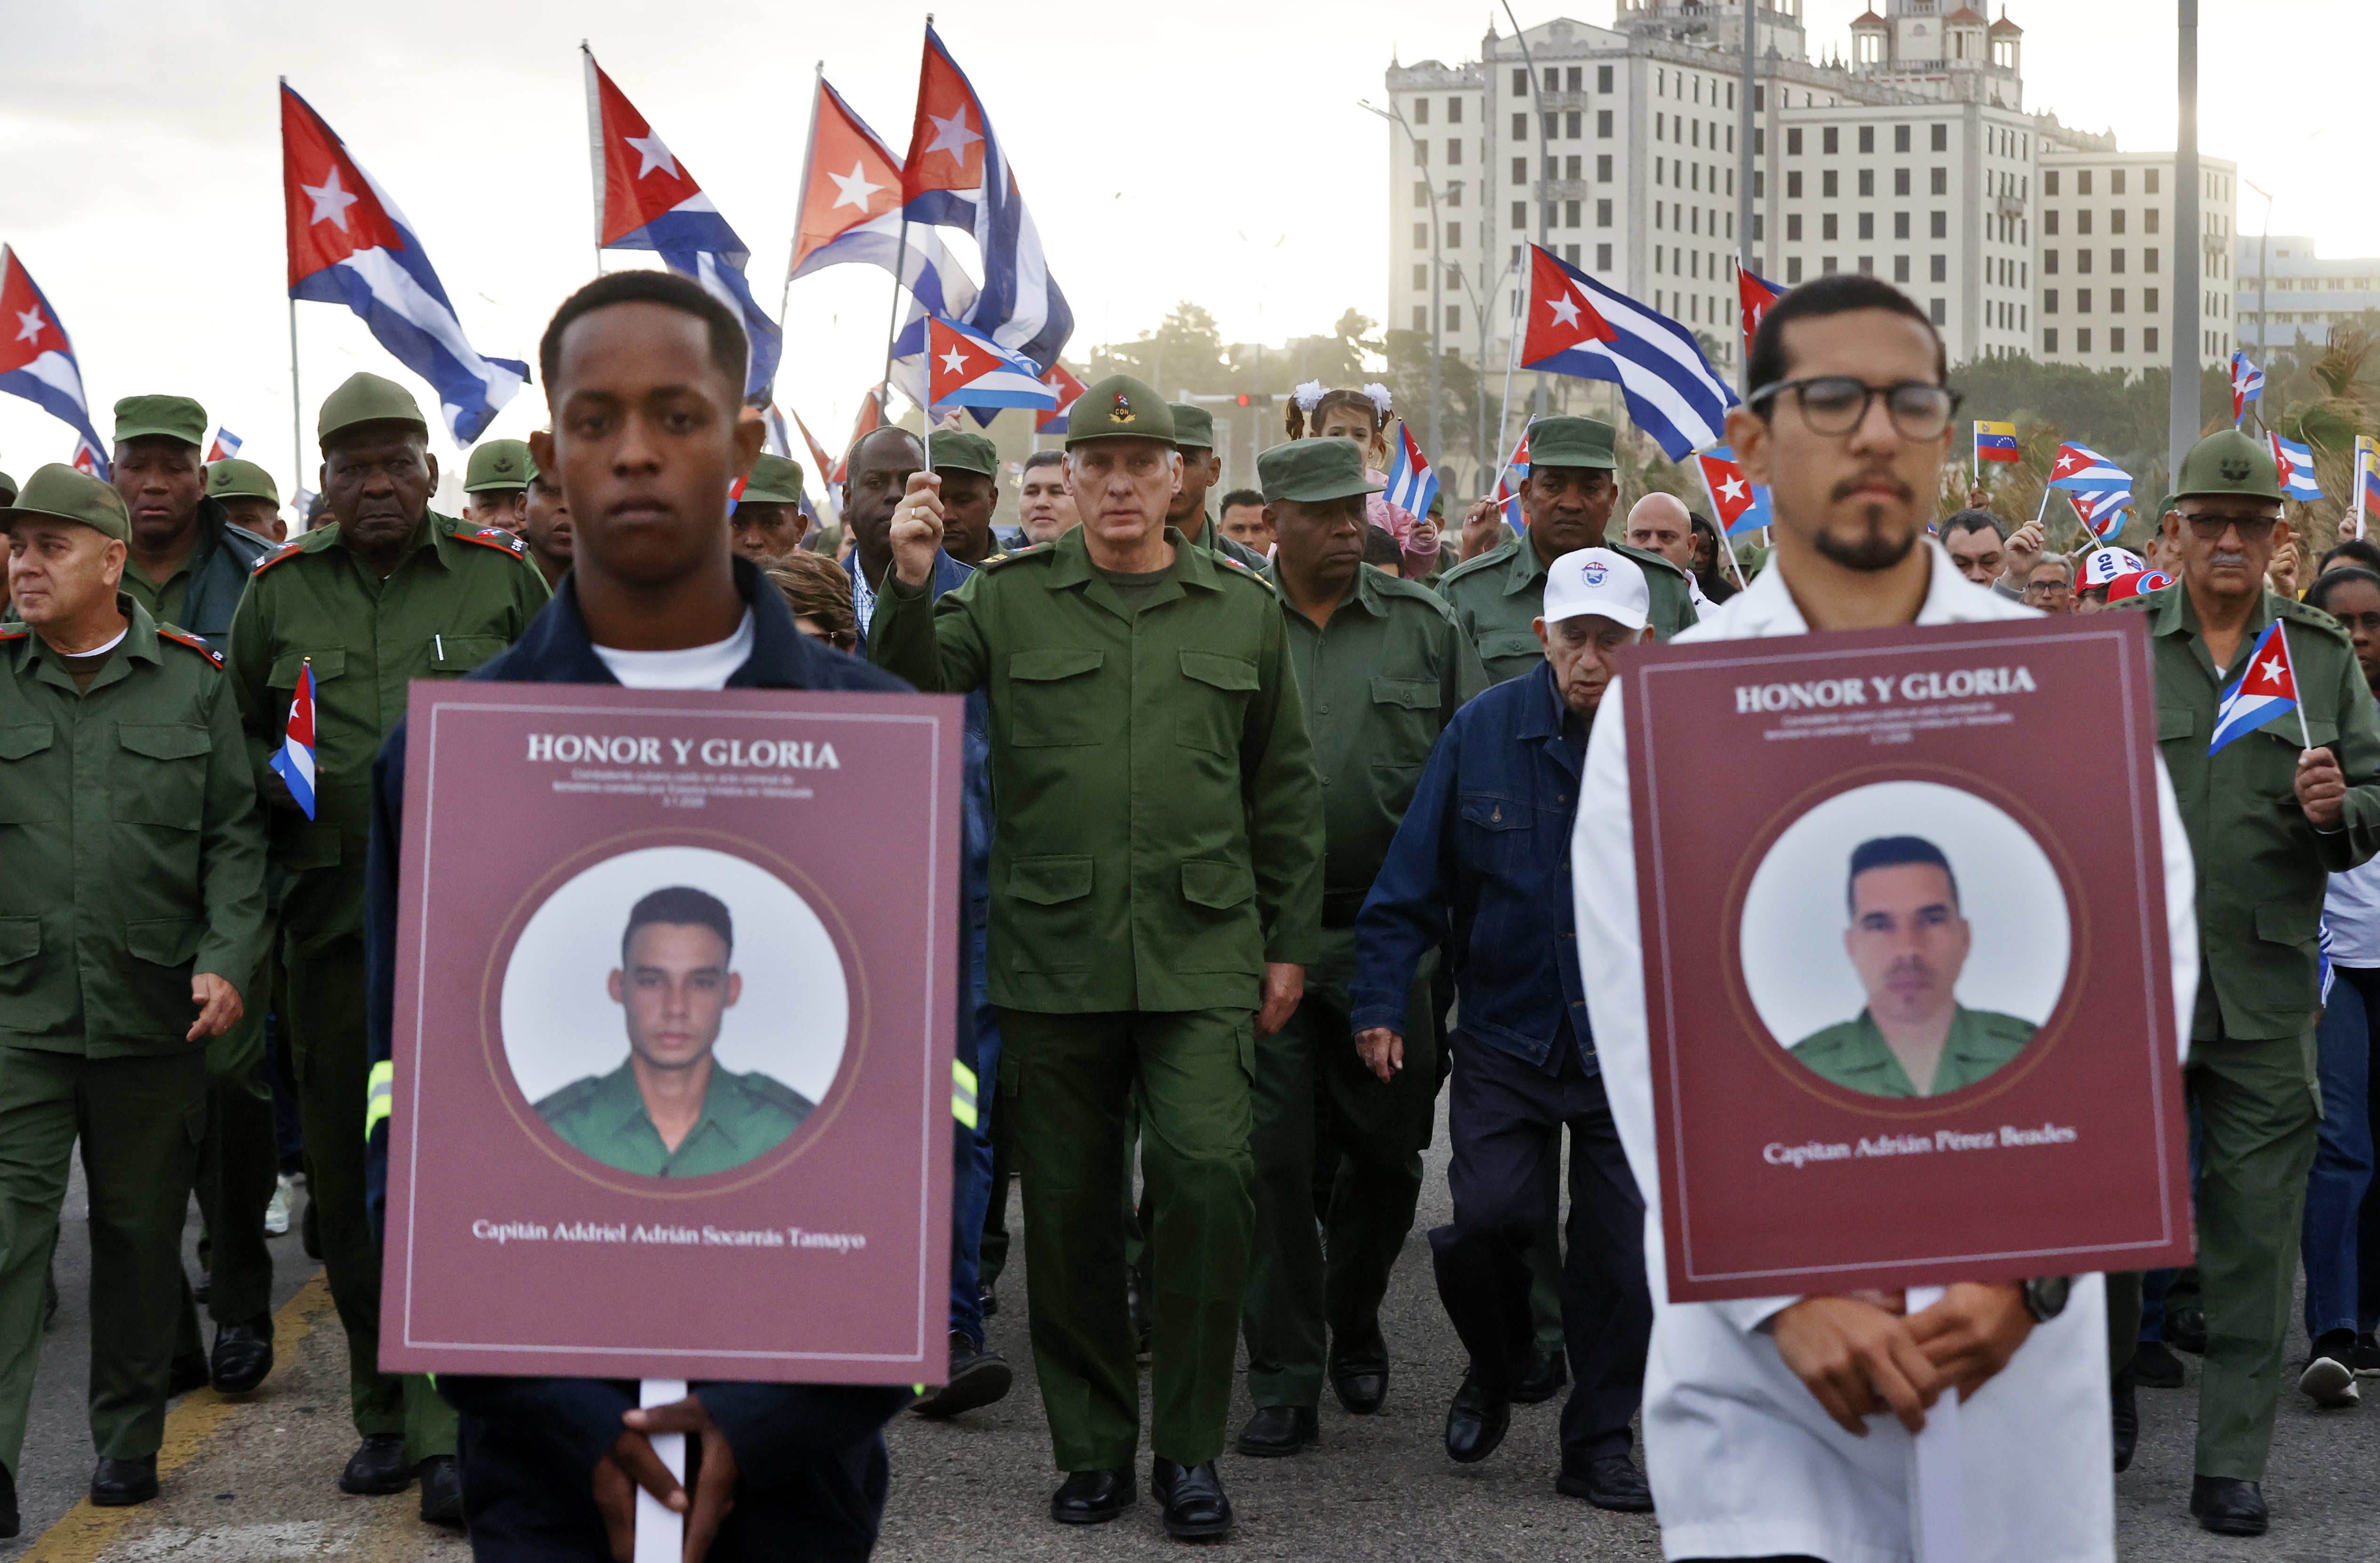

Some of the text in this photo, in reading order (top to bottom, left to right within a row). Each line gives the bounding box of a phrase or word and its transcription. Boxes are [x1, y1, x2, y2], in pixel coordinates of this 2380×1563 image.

[1735, 666, 2037, 713] HONOR Y GLORIA
[526, 733, 840, 769] HONOR Y GLORIA
[472, 1218, 549, 1244] Capitán
[553, 1221, 627, 1242] Addriel
[631, 1223, 700, 1244] Adrián
[786, 1227, 867, 1254] Tamayo
